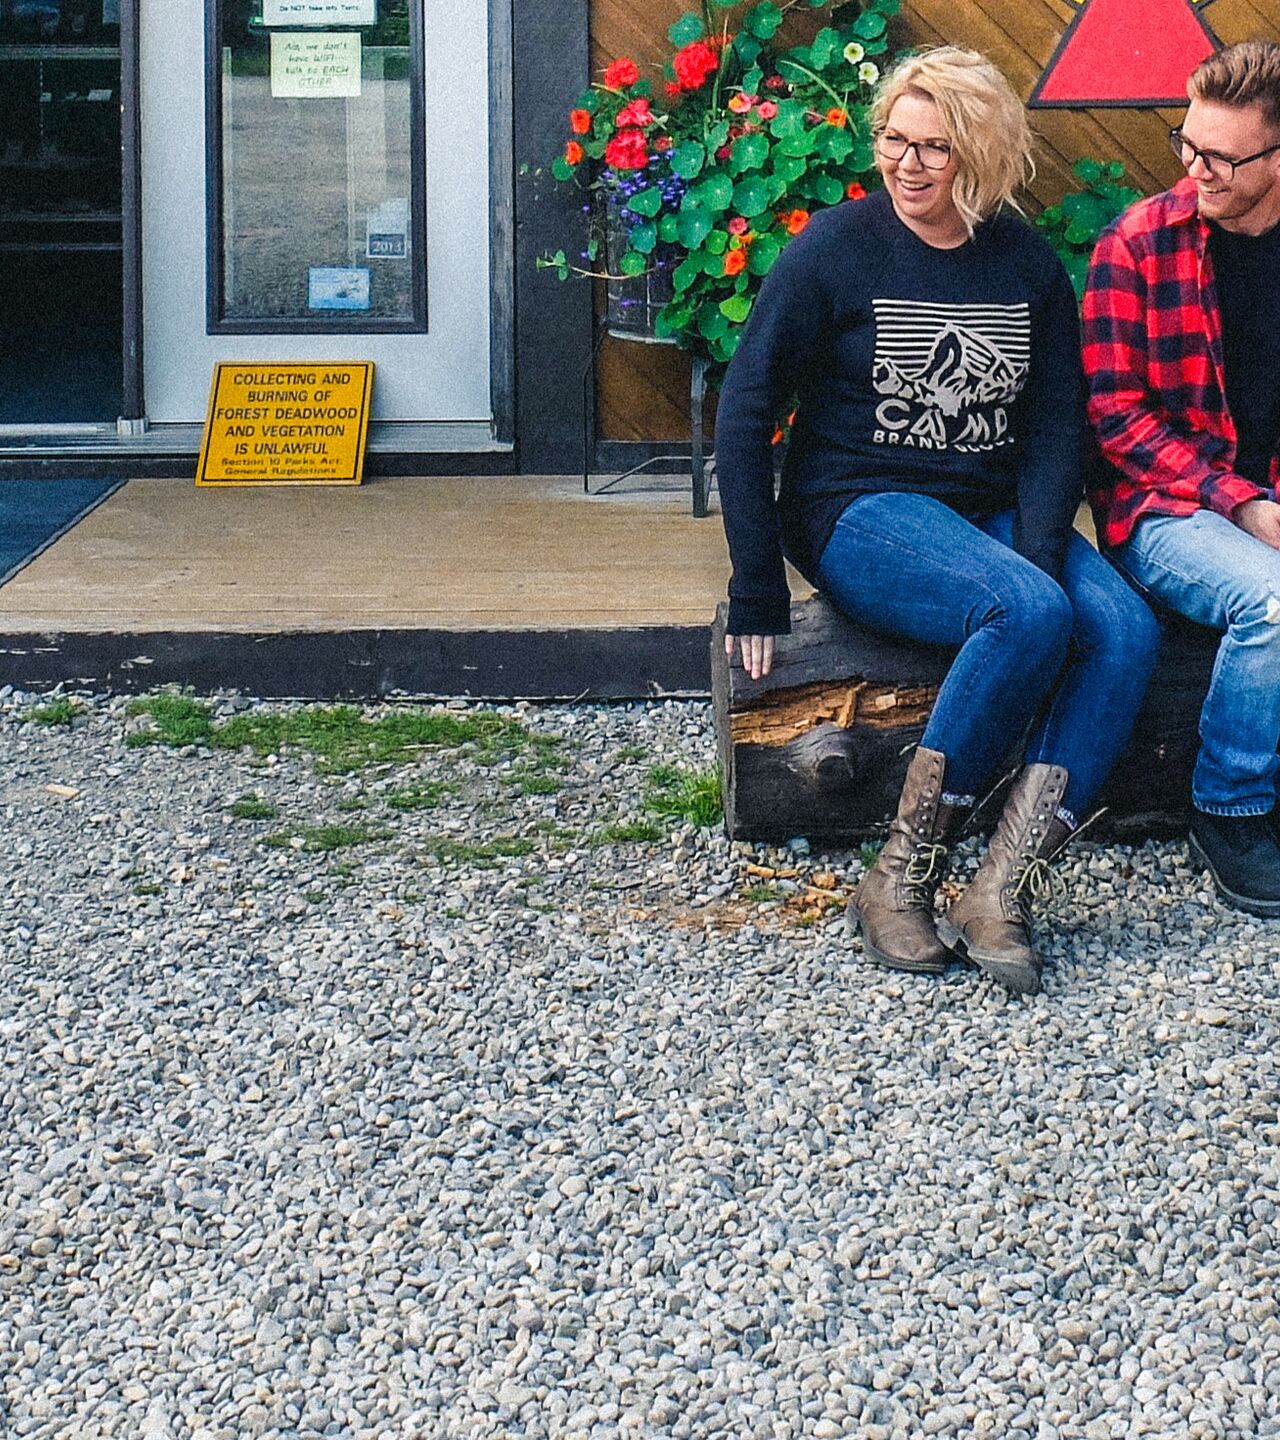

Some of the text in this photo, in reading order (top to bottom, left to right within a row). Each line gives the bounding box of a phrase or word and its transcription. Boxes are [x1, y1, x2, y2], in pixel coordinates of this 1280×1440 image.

[323, 65, 349, 74] EACH
[233, 373, 351, 385] COLLECTING AND
[247, 390, 332, 402] BURNING OF
[216, 408, 357, 419] FOREST DEADWOOD
[225, 425, 345, 437] AND VEGETATION
[235, 442, 328, 455] IS UNLAWFUL
[222, 457, 264, 466] Section
[285, 457, 315, 465] Parks
[225, 467, 336, 477] General Regulations
